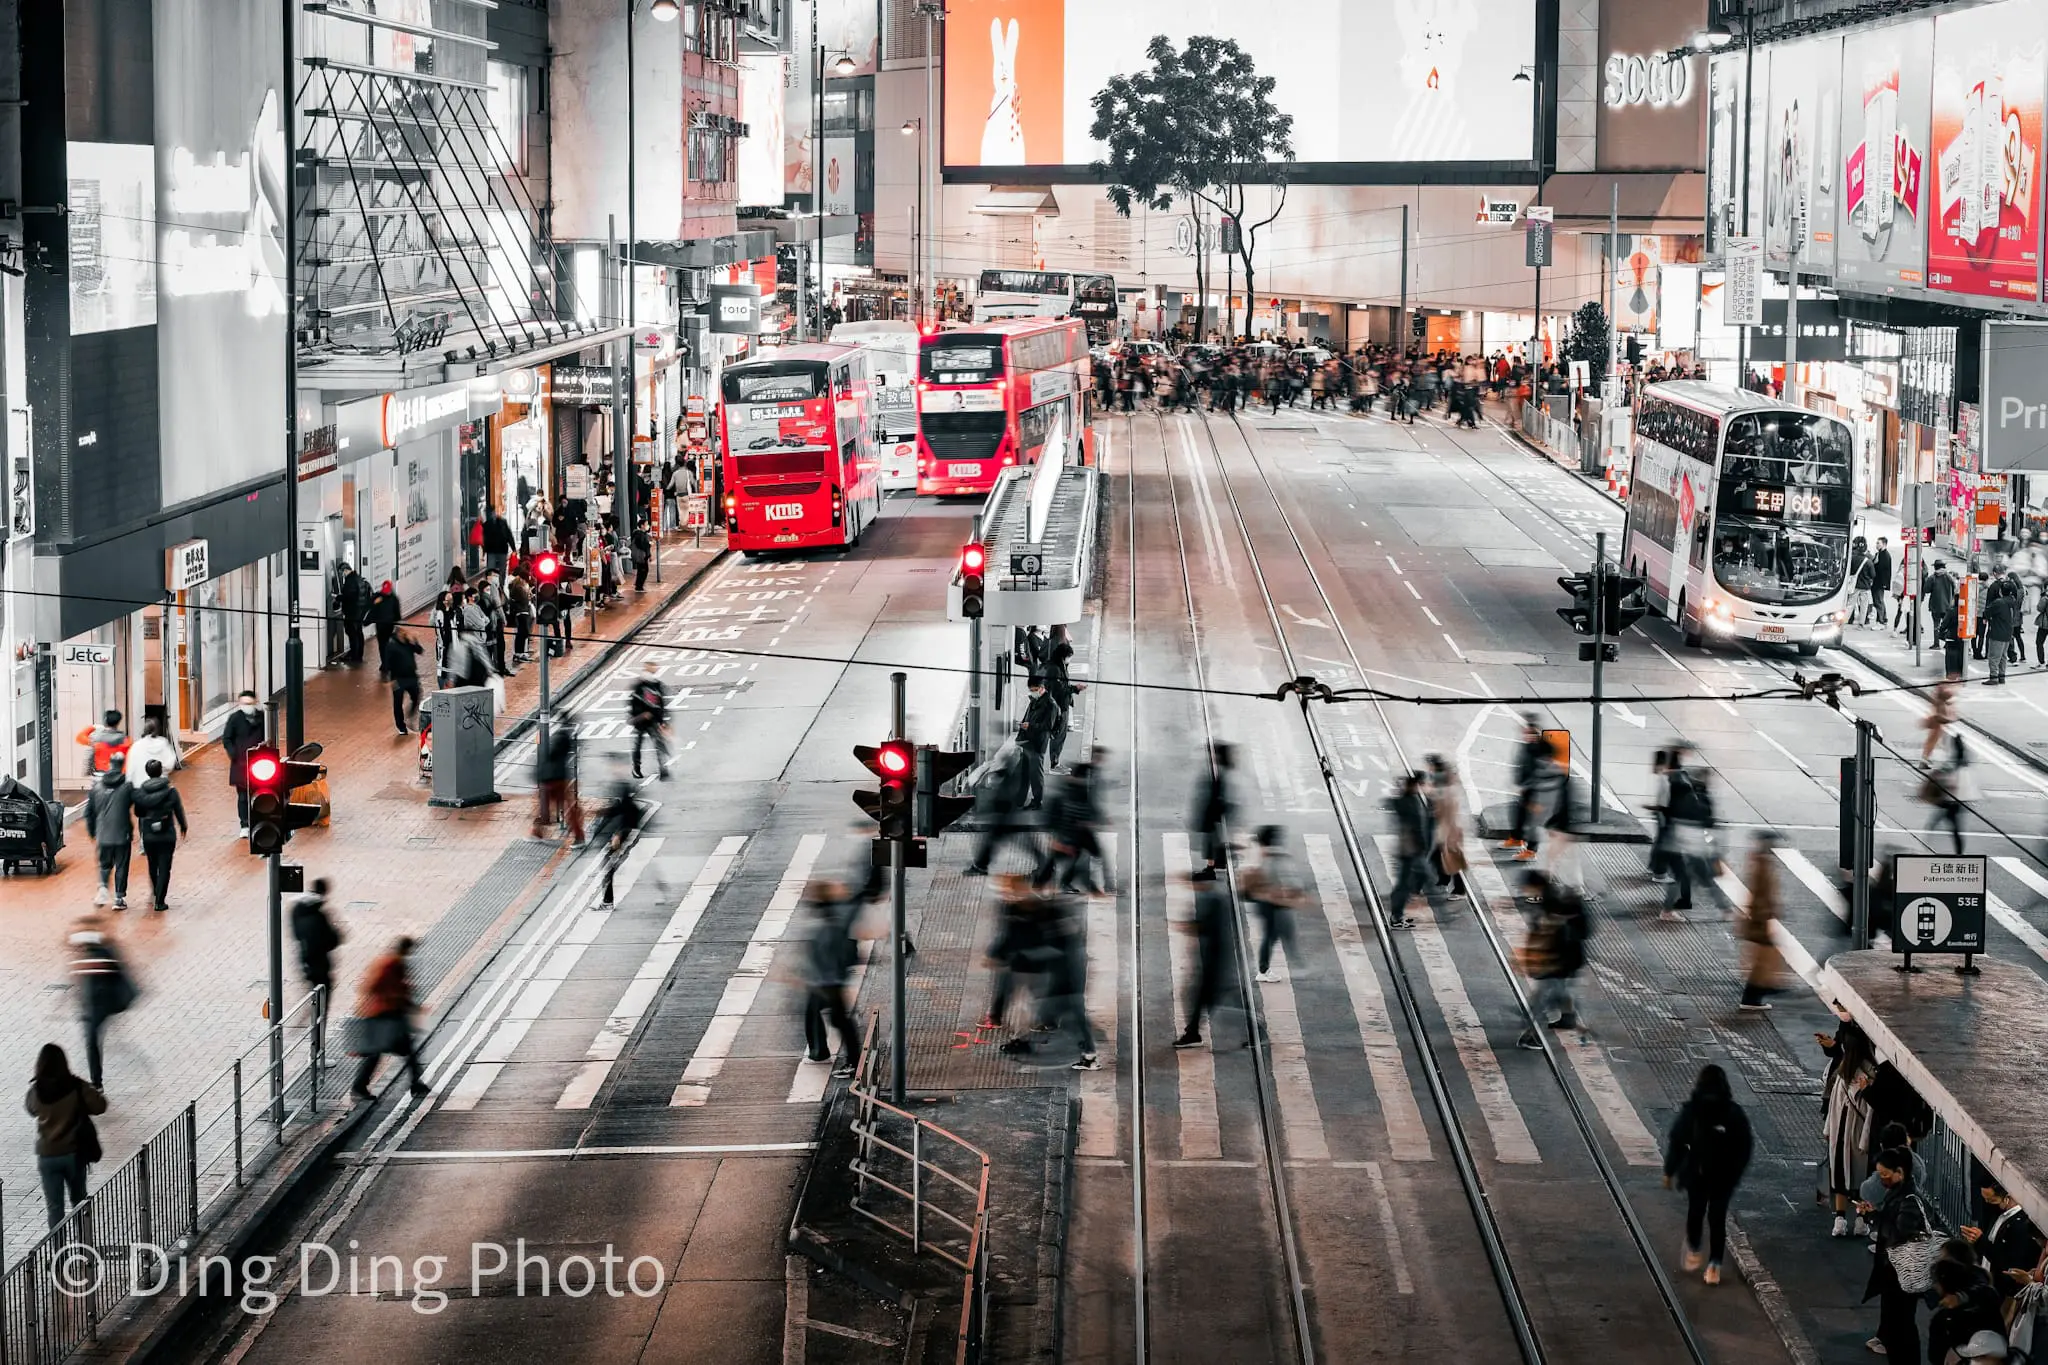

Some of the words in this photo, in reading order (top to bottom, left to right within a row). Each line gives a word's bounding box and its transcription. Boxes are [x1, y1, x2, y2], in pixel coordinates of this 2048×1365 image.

[1604, 55, 1686, 105] SOGO
[1737, 257, 1746, 289] HONG
[1737, 289, 1746, 321] KONG
[1760, 324, 1788, 336] TS
[948, 463, 983, 478] KMB
[765, 502, 804, 521] KMB
[1792, 495, 1821, 515] 603
[715, 576, 807, 589] BUS
[689, 589, 805, 603] STOP
[680, 605, 779, 624] 巴士
[671, 625, 749, 643] 站
[638, 648, 740, 662] BUS
[613, 662, 742, 679] STOP
[1930, 863, 1979, 874] 百德新街
[1958, 897, 1979, 907] 53E
